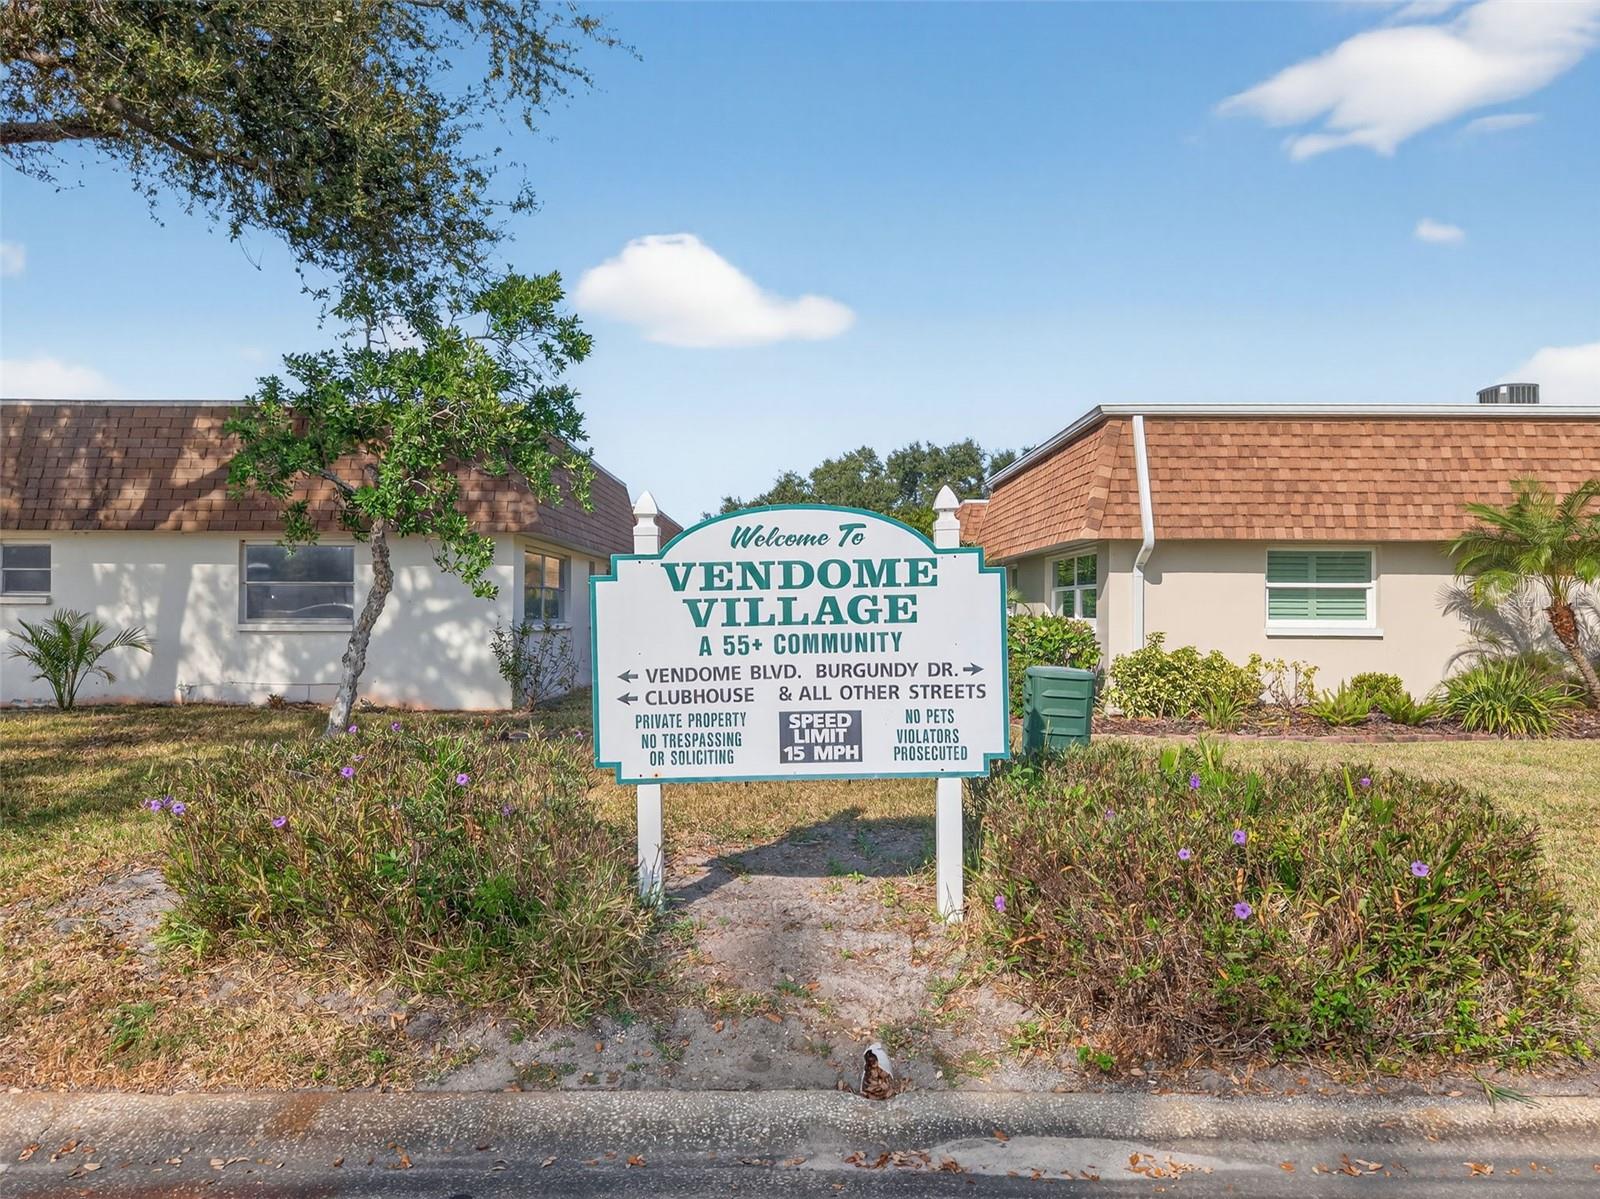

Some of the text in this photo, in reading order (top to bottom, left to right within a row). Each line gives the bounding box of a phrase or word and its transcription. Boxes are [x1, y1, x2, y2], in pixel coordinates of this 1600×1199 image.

[731, 523, 866, 549] Welcome To
[661, 558, 937, 591] VENDOME
[682, 594, 917, 627] VILLAGE
[699, 632, 902, 656] A 55+ COMMUNITY
[646, 662, 958, 683] VENDOME BLVD. BURGUNDY DR.
[645, 684, 986, 705] CLUBHOUSE & ALL OTHER STREETS
[636, 712, 746, 729] PRIVATE PROPERTY
[789, 713, 852, 729] SPEED
[906, 709, 954, 724] NO PETS
[642, 732, 741, 749] NO TRESPASSING
[794, 729, 847, 743] LIMIT
[897, 729, 959, 743] VIOLATORS
[650, 749, 734, 766] OR SOLICITING
[784, 745, 858, 760] 15 MPH
[894, 746, 967, 761] PROSECUTED
